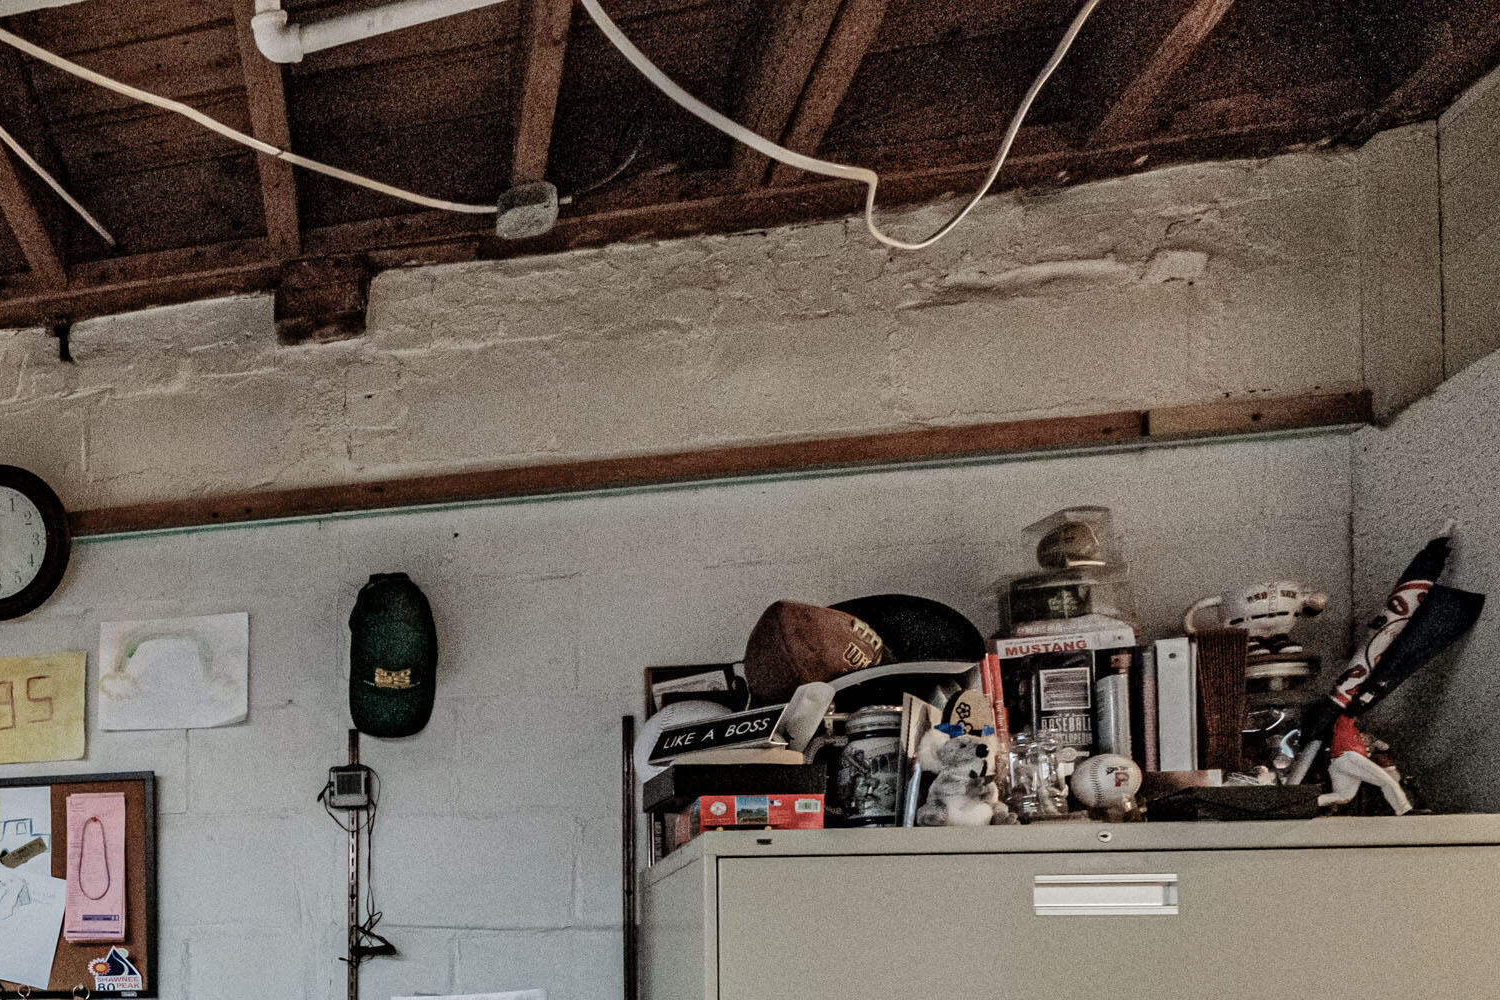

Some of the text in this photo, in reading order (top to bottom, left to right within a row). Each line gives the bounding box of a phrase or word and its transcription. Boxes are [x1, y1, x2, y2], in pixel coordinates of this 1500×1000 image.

[9, 497, 15, 512] 1
[23, 511, 32, 526] 2
[32, 532, 40, 546] 3
[1005, 640, 1088, 657] MUSTANG
[1041, 717, 1092, 731] BASEBALL
[663, 718, 770, 749] LIKE A BOSS
[97, 983, 115, 991] 80
